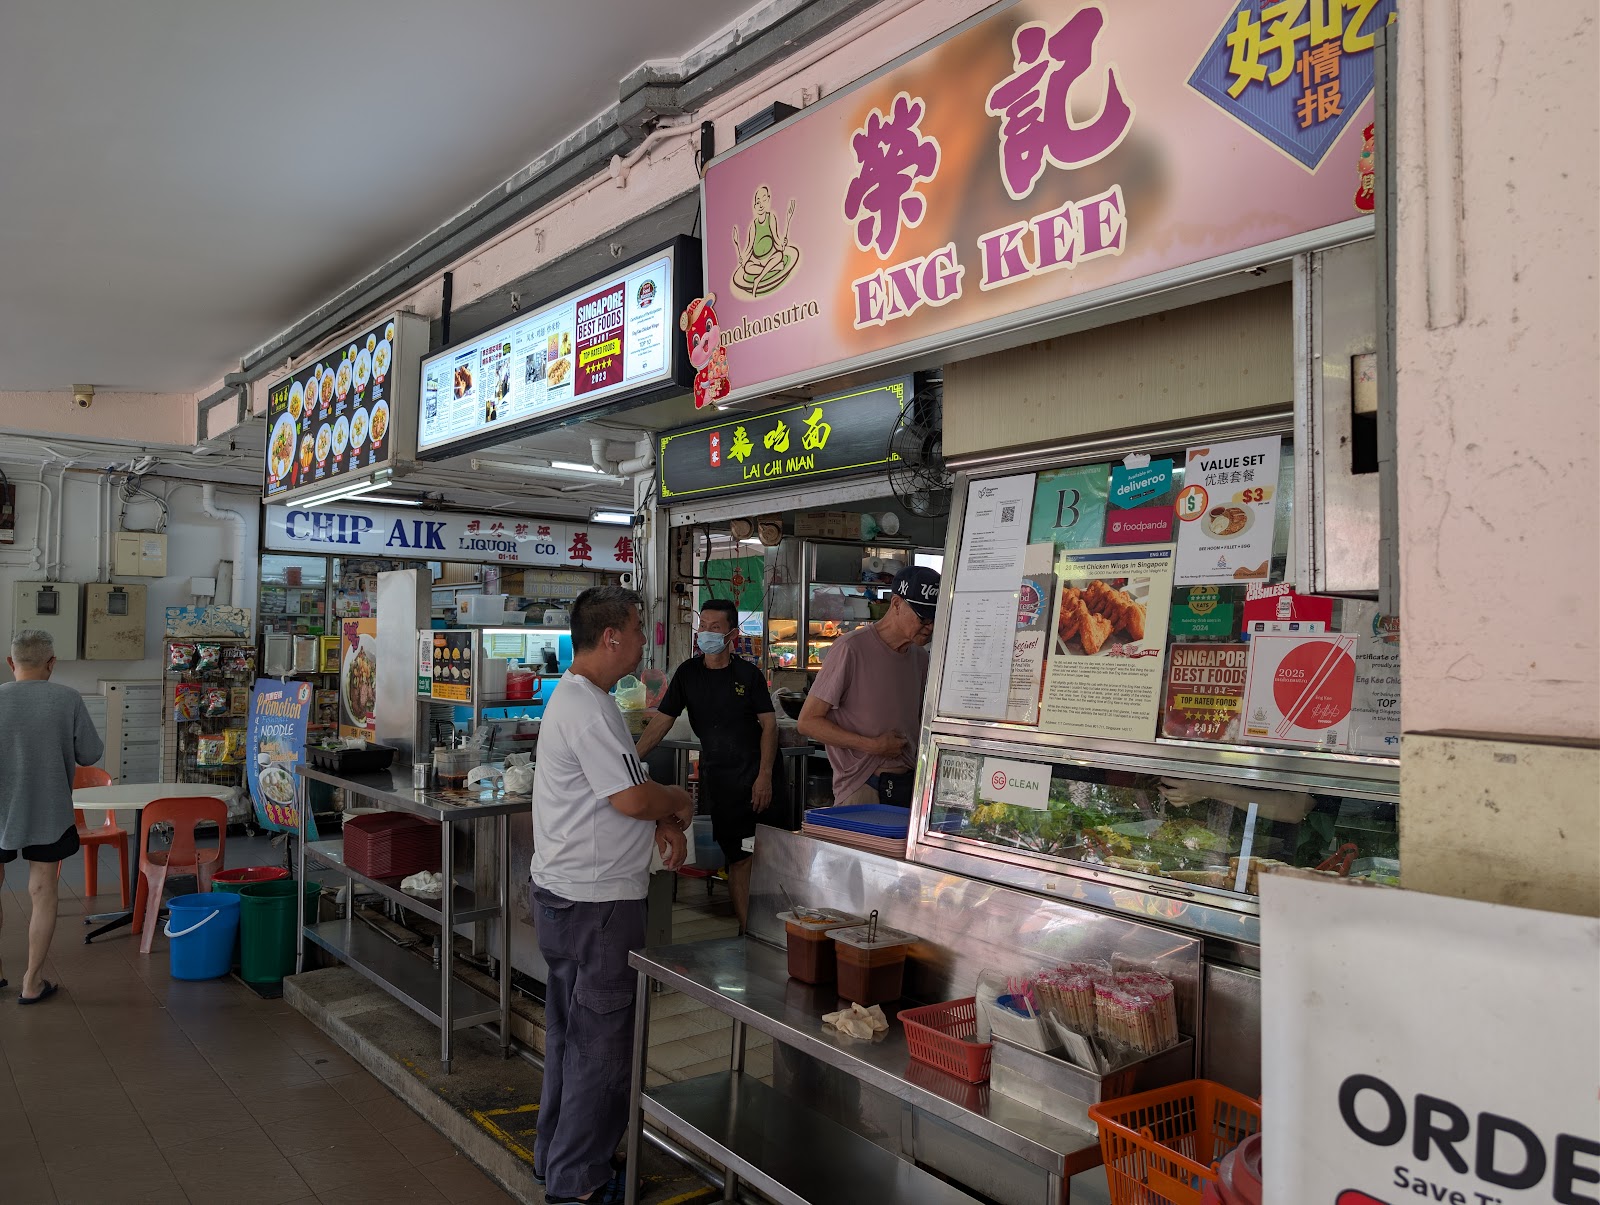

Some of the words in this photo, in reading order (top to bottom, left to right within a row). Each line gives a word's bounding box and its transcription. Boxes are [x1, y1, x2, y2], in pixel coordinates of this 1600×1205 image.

[1297, 41, 1344, 129] 情报
[856, 244, 963, 329] ENG
[980, 187, 1127, 291] KEE
[578, 290, 623, 323] SINGAPORE
[578, 320, 596, 340] BEST
[597, 310, 621, 333] FOODS
[720, 300, 820, 346] makansutra
[590, 332, 609, 346] ENJOY
[590, 346, 602, 357] RATED
[602, 341, 615, 353] FOODS
[591, 371, 607, 384] 2023
[727, 407, 832, 463] 来吃面
[743, 463, 760, 479] LAI
[763, 459, 782, 477] CHI
[785, 453, 814, 473] MIAN
[1200, 457, 1240, 472] VALUE
[1242, 454, 1265, 466] SET
[1117, 473, 1166, 496] deliveroo
[1205, 469, 1255, 486] 优惠套餐
[1242, 487, 1264, 504] $3
[1051, 488, 1080, 529] B
[286, 510, 374, 545] CHIP
[385, 518, 447, 550] AIK
[1123, 520, 1167, 532] foodpanda
[458, 537, 517, 553] LIQUOR
[535, 543, 559, 555] CO.
[1246, 583, 1290, 601] CASHLESS
[1173, 650, 1248, 668] SINGAPOR
[1355, 653, 1389, 661] ertificate
[1173, 668, 1204, 682] BEST
[1208, 669, 1247, 684] FOODS
[1278, 669, 1305, 677] 2025
[1356, 675, 1369, 685] Eng
[1370, 676, 1384, 684] Kee
[1193, 685, 1226, 694] ENJOY
[256, 692, 302, 719] Promotion
[1181, 696, 1192, 704] TOP
[1194, 697, 1214, 705] RATED
[1216, 698, 1237, 706] FOODS
[1377, 699, 1397, 708] TOP
[260, 723, 295, 737] NOODLE
[1194, 722, 1220, 733] 2017
[943, 766, 975, 780] WINGS
[993, 775, 1005, 785] SG
[1009, 778, 1040, 790] CLEAN
[1393, 1166, 1466, 1205] Save
